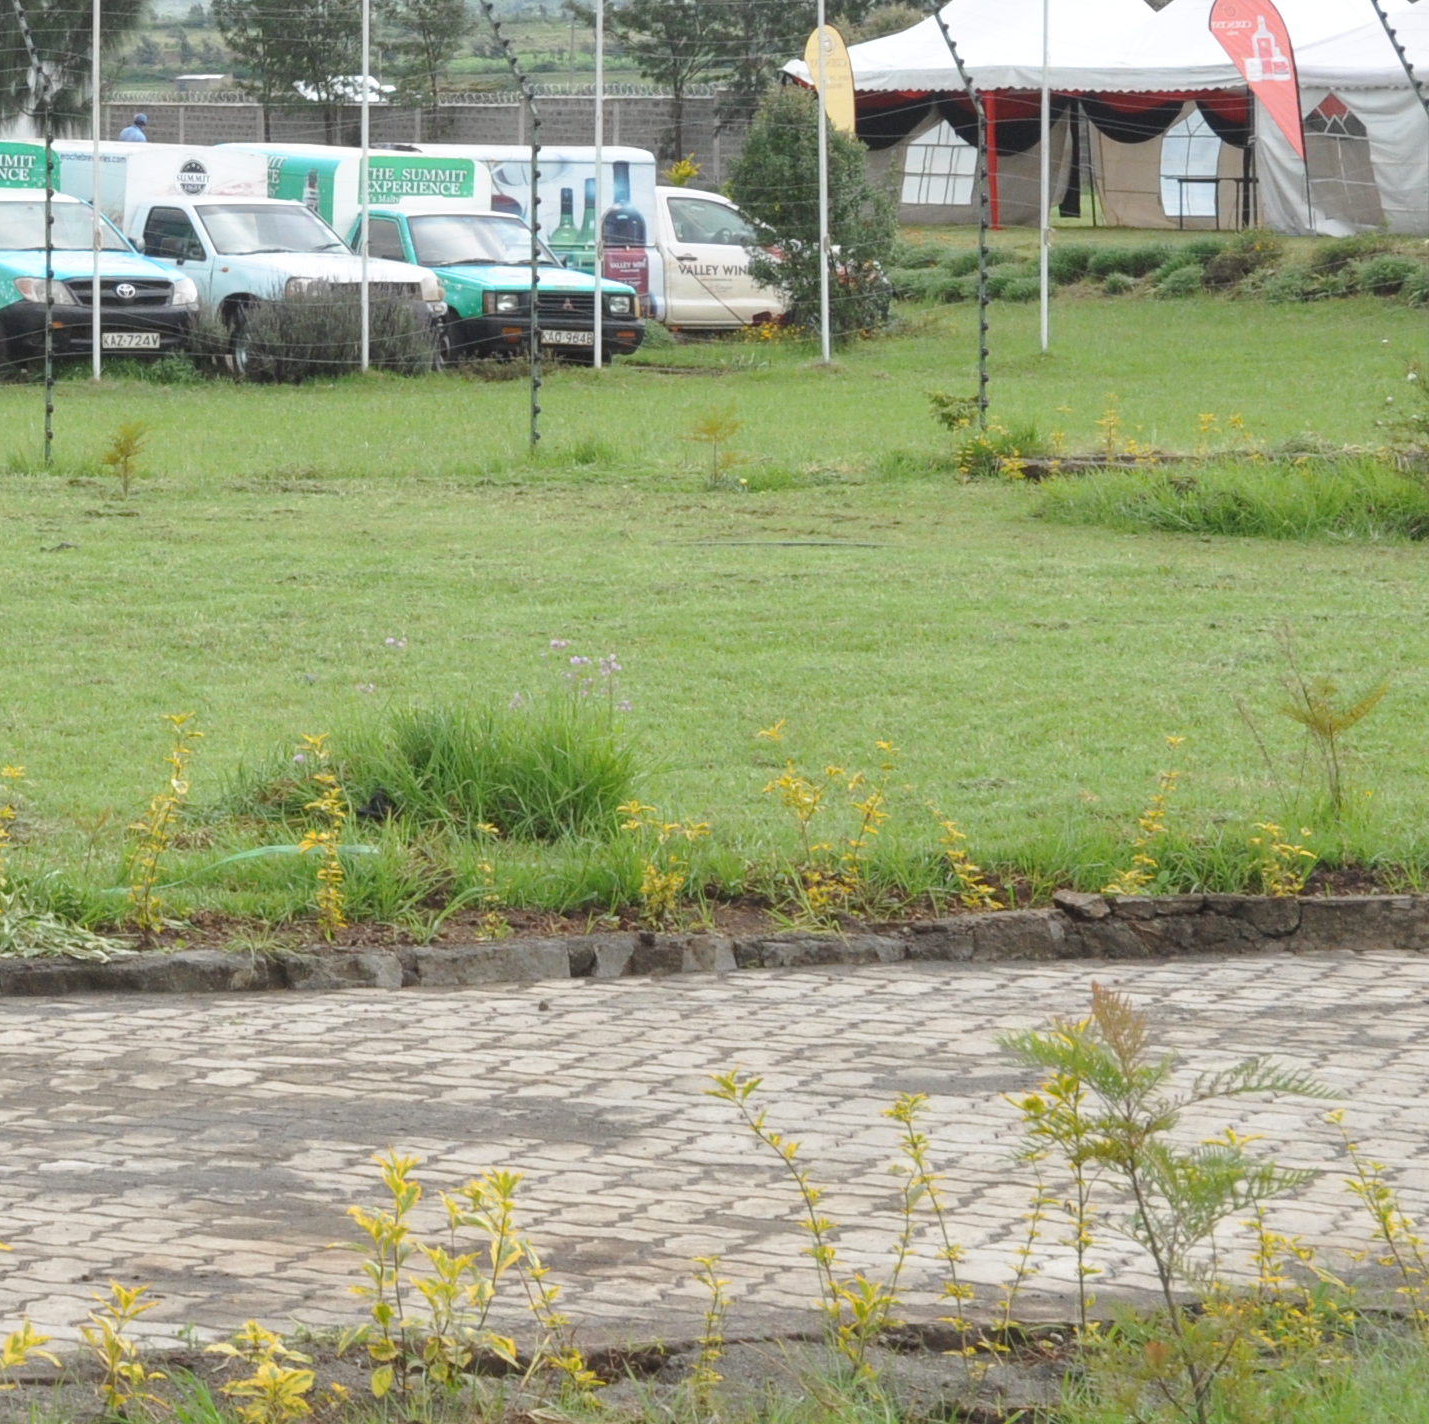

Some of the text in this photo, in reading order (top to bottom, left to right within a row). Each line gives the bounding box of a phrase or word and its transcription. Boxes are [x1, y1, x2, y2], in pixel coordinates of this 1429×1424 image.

[176, 174, 211, 183] SUMMIT
[401, 168, 467, 182] SUMMIT
[678, 264, 719, 276] VALLEY
